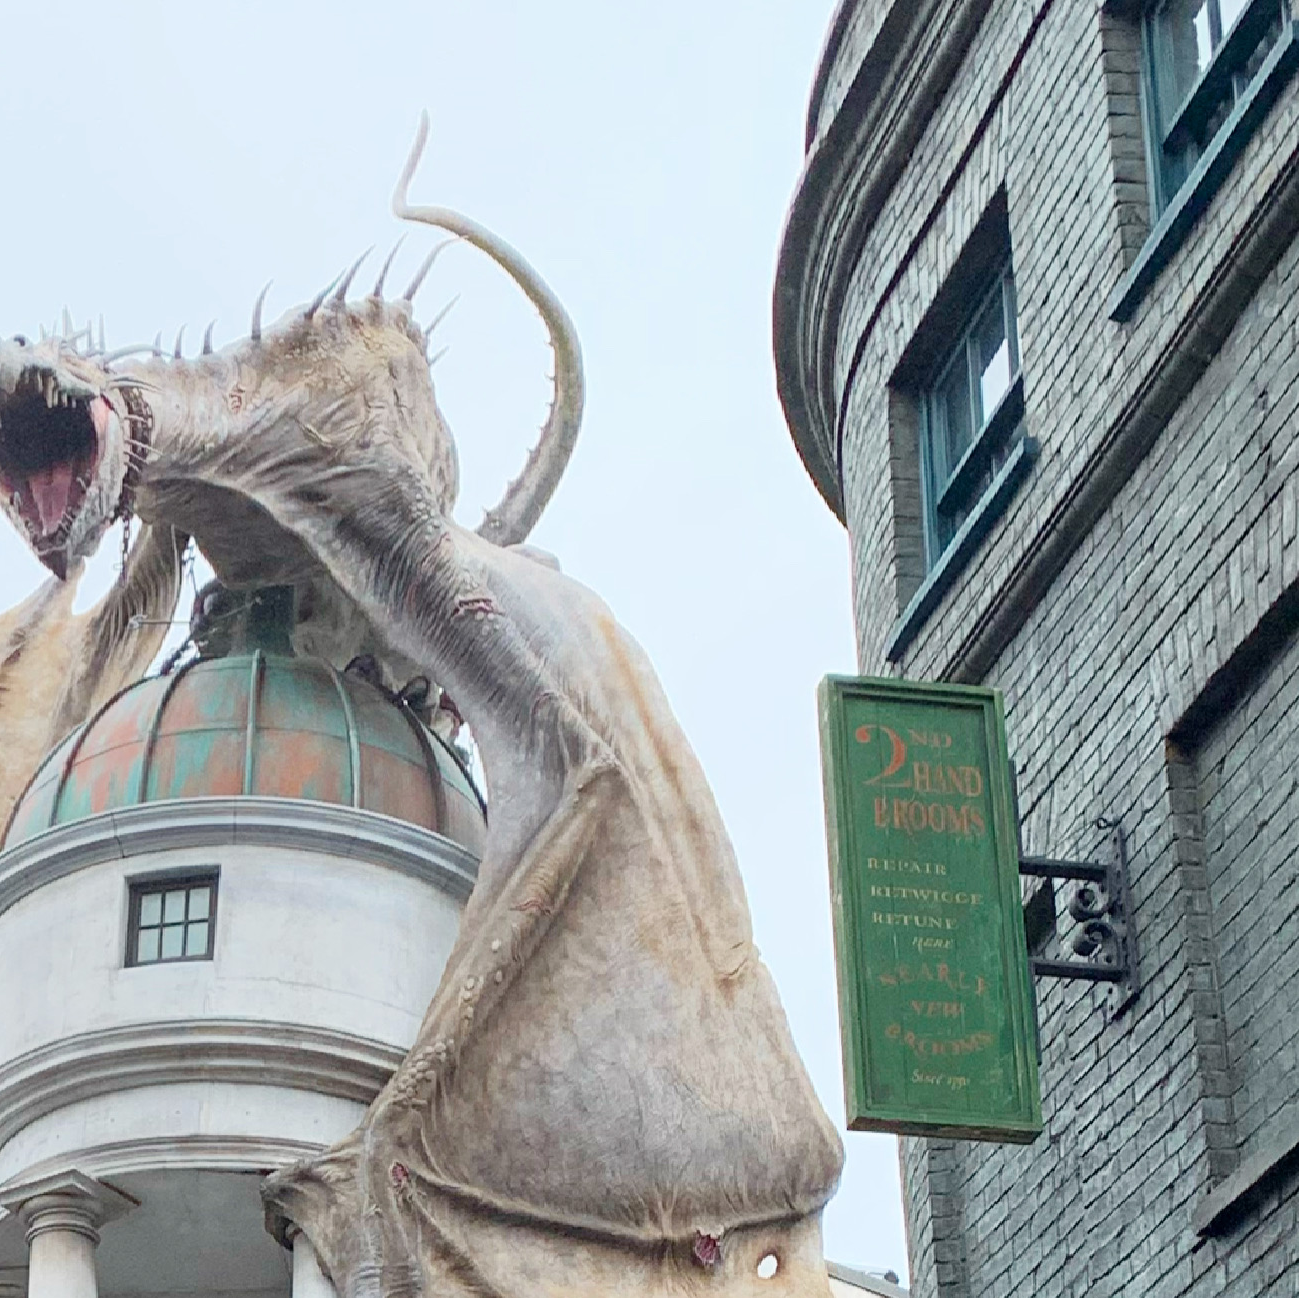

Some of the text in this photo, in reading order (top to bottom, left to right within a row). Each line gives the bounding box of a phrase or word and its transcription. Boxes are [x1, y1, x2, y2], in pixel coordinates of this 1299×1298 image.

[913, 760, 984, 797] HAND
[874, 796, 986, 837] BROOMS
[867, 857, 947, 876] REPAIR
